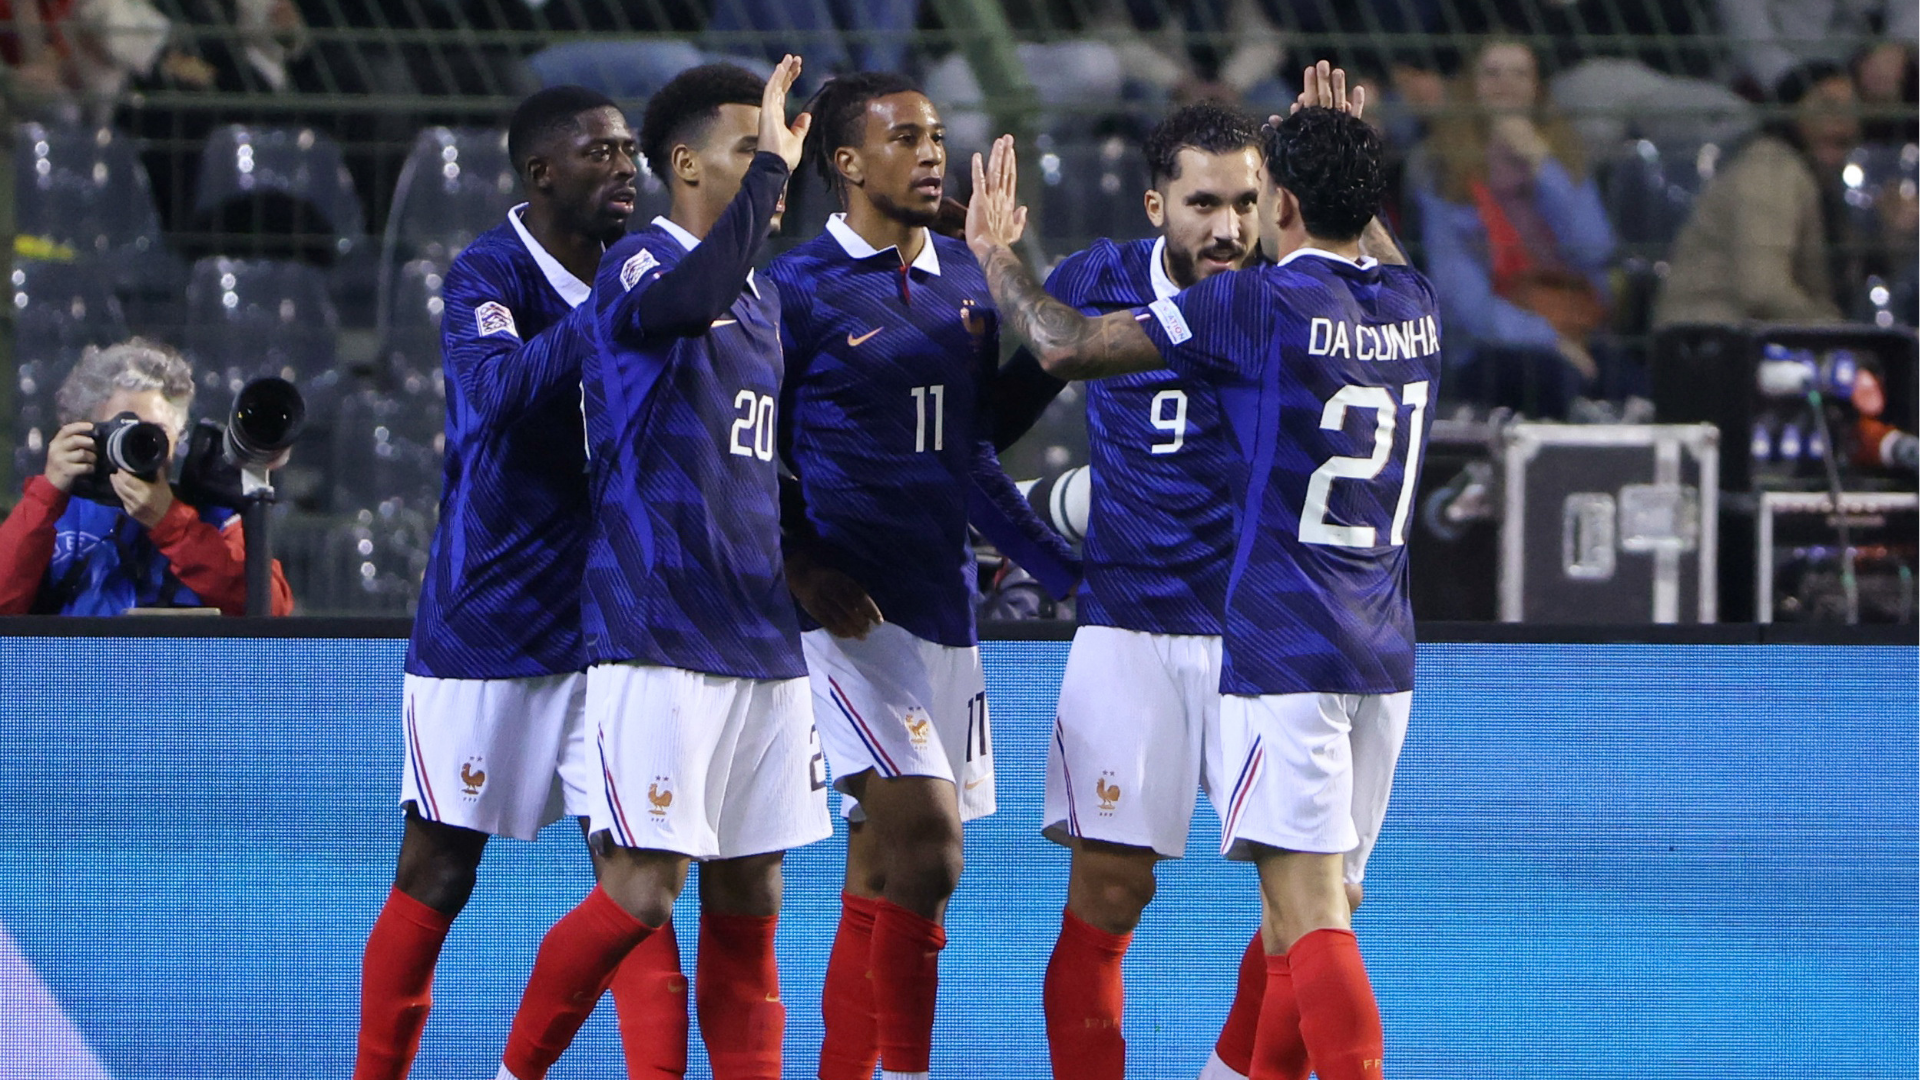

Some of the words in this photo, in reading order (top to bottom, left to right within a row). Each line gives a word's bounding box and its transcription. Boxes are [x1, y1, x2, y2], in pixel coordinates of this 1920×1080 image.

[1308, 317, 1350, 359] DA
[1356, 315, 1440, 361] CUNHA
[730, 389, 774, 462] 20
[911, 385, 944, 453] 11
[1150, 390, 1188, 454] 9
[1298, 380, 1429, 548] 21
[809, 724, 827, 792] 2
[967, 690, 987, 762] 11
